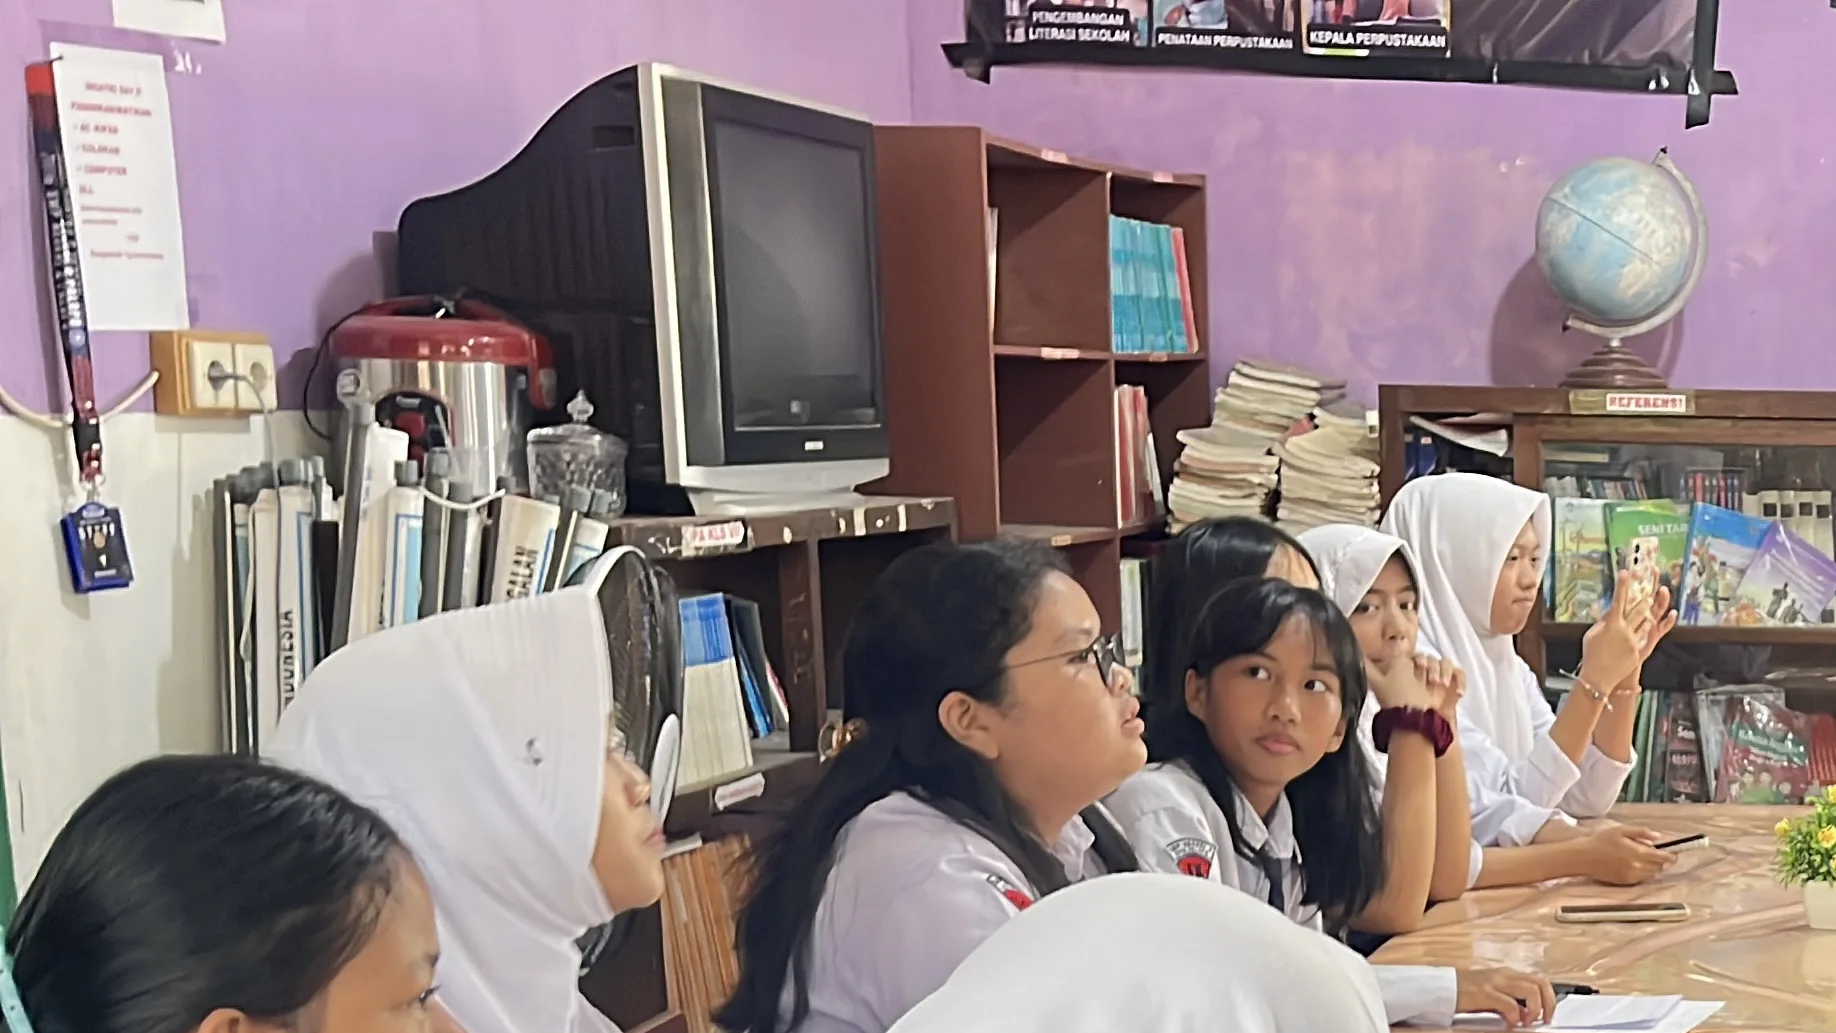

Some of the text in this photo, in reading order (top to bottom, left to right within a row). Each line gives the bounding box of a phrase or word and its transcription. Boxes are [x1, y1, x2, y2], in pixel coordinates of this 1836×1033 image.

[1032, 10, 1124, 26] PENGEMBANGAN
[1029, 26, 1131, 42] LITERASI SEKOLAH
[1158, 34, 1293, 49] PENATAAN PERPUSTAKAAN
[1309, 31, 1446, 48] KEPALA PERPUSTAKAAN
